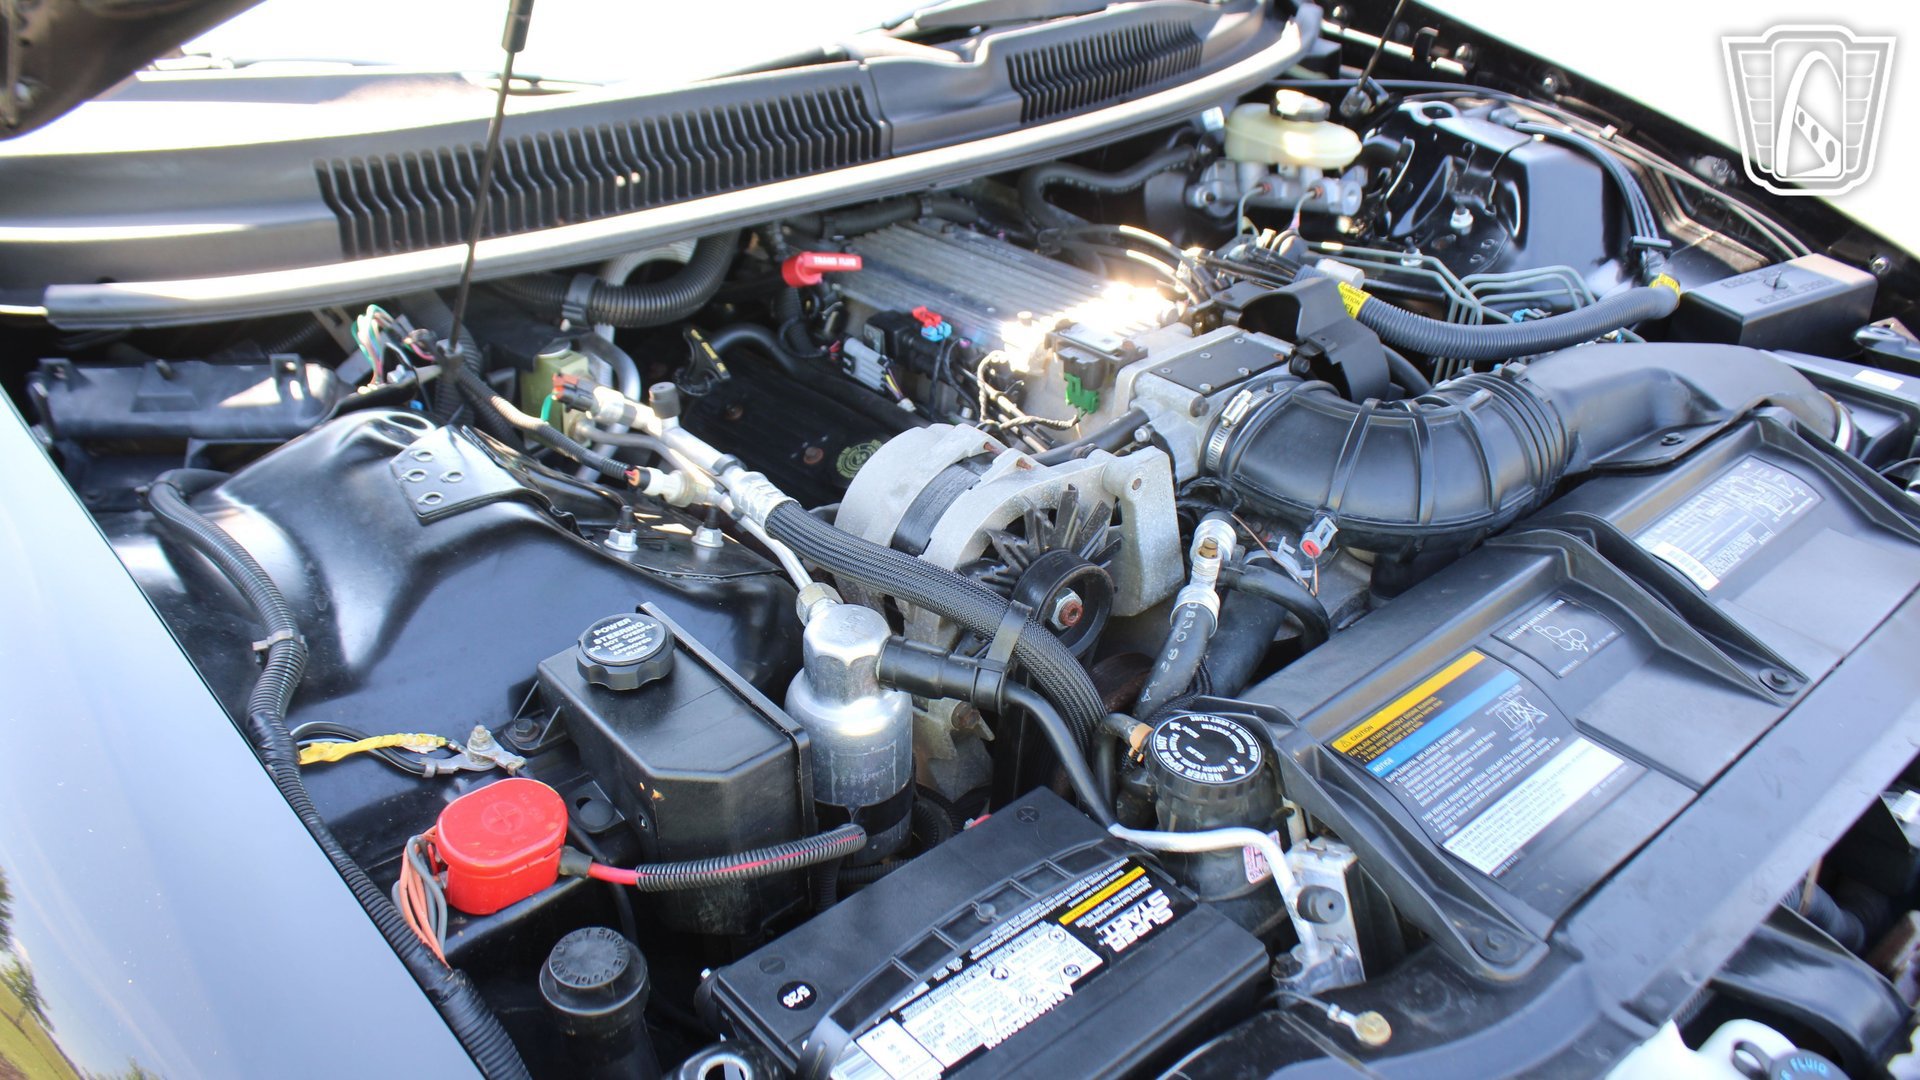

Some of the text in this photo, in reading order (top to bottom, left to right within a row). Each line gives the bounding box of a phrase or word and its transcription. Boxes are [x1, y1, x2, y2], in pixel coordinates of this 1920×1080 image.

[593, 618, 631, 636] POWER
[593, 621, 645, 645] STEERING
[603, 638, 618, 648] NOT
[621, 623, 657, 640] OVERFILL
[608, 633, 646, 651] USE ONLY
[613, 637, 652, 656] APPROVED
[625, 645, 647, 656] FLUID
[1350, 725, 1374, 741] CAUTION
[1156, 735, 1168, 750] HOT
[1160, 751, 1185, 771] OPEN
[1201, 765, 1228, 773] CHECK
[1373, 757, 1394, 773] NOTICE
[1184, 768, 1223, 781] NEVER
[1099, 889, 1170, 937] START
[1108, 905, 1174, 952] SUPER
[1790, 1056, 1828, 1074] FLUID
